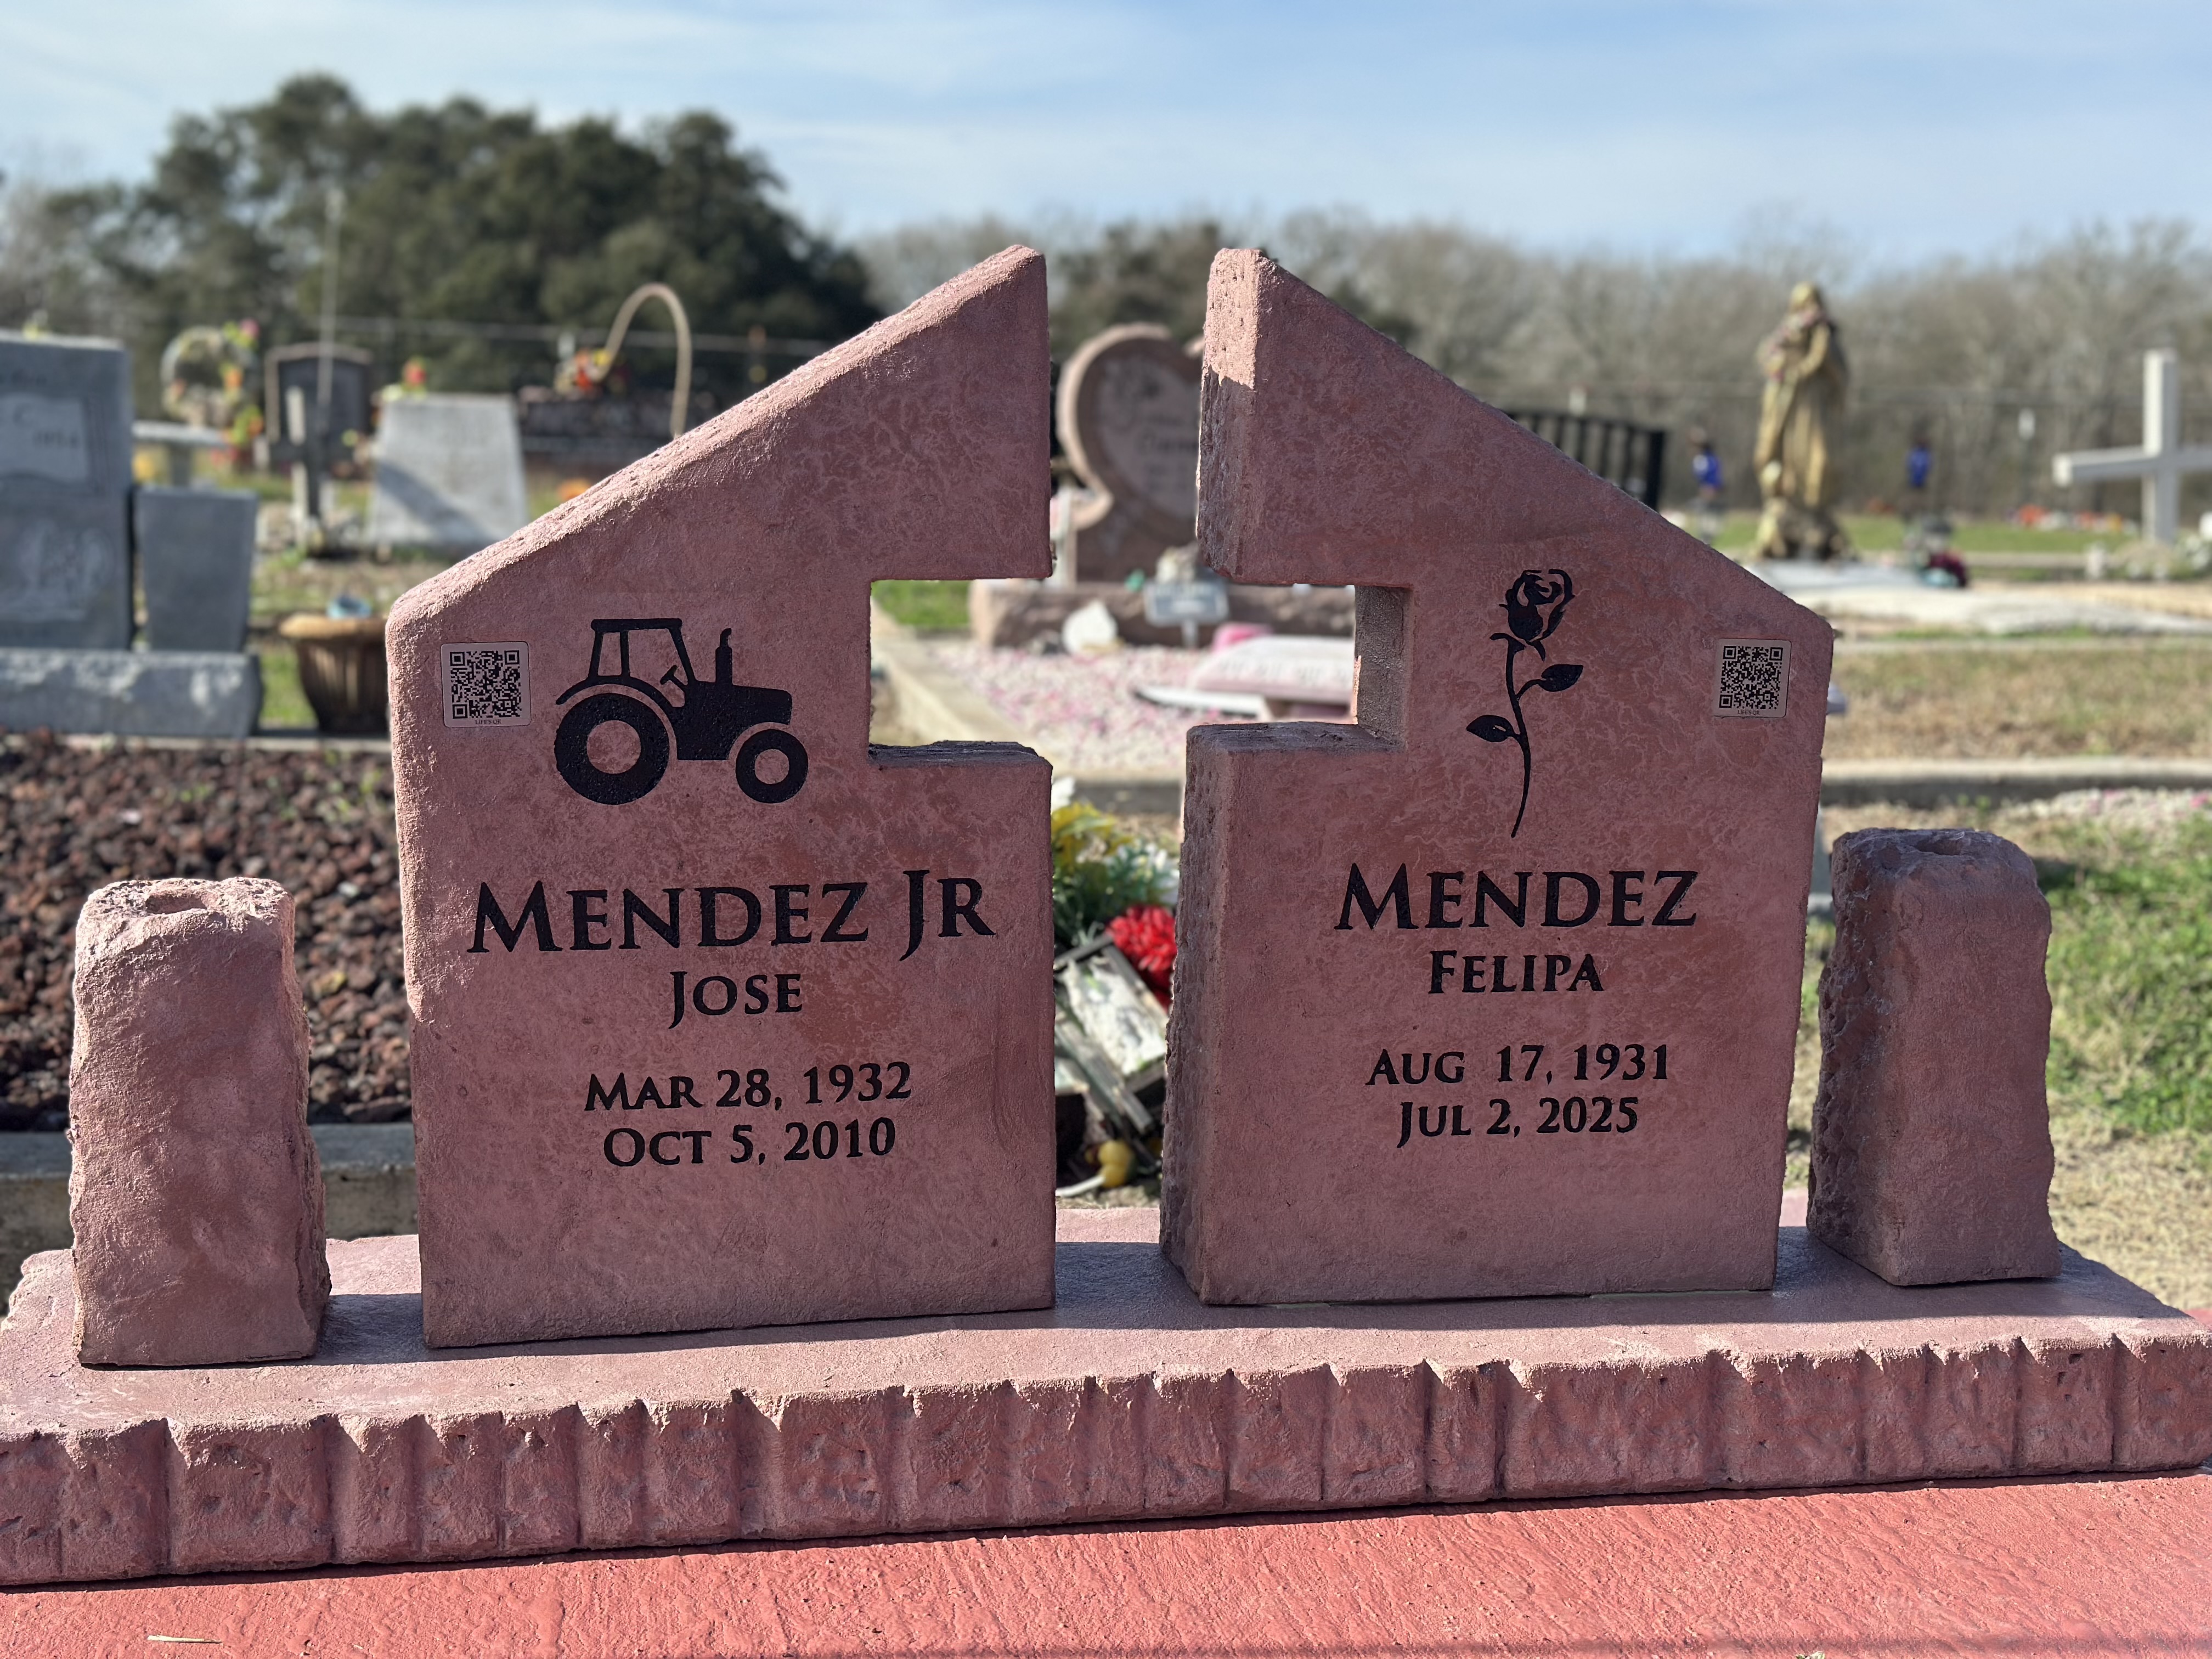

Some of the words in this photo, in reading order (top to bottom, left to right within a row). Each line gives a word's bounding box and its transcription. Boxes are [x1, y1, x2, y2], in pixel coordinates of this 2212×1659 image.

[467, 881, 868, 953] MENDEZ
[899, 870, 996, 961] JR
[1334, 863, 1698, 930] MENDEZ
[1428, 950, 1604, 994] FELIPA
[668, 971, 802, 1029] JOSE
[584, 1073, 703, 1112] MAR
[716, 1069, 782, 1110] 28,
[804, 1062, 911, 1105] 1932
[1365, 1049, 1465, 1085] AUG
[1497, 1045, 1552, 1085] 17,
[1574, 1043, 1667, 1080] 1931
[604, 1128, 712, 1167] OCT
[731, 1125, 765, 1165] 5,
[784, 1117, 895, 1161] 2010
[1397, 1102, 1471, 1148] JUL
[1487, 1099, 1520, 1137] 2,
[1537, 1095, 1638, 1133] 2025
